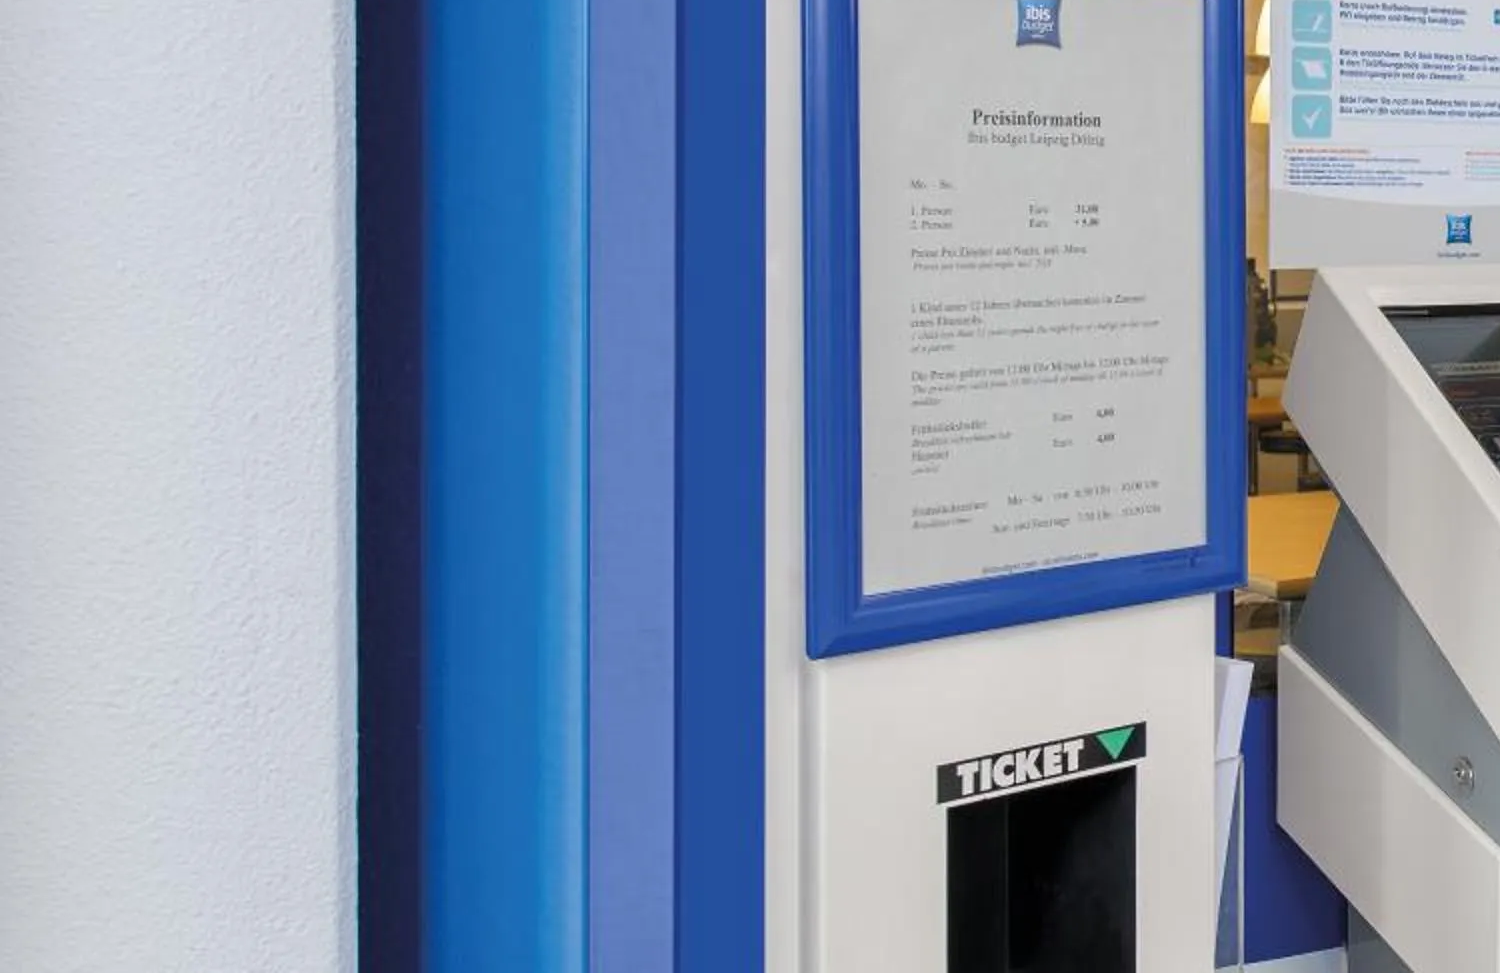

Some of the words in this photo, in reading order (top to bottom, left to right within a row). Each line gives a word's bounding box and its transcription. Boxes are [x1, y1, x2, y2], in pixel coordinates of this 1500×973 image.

[1025, 4, 1051, 21] ibis
[1022, 20, 1054, 33] budget
[972, 108, 1102, 128] Preisinformation
[991, 131, 1028, 147] budget
[1029, 132, 1069, 148] Leipzig
[955, 738, 1085, 796] TICKET
